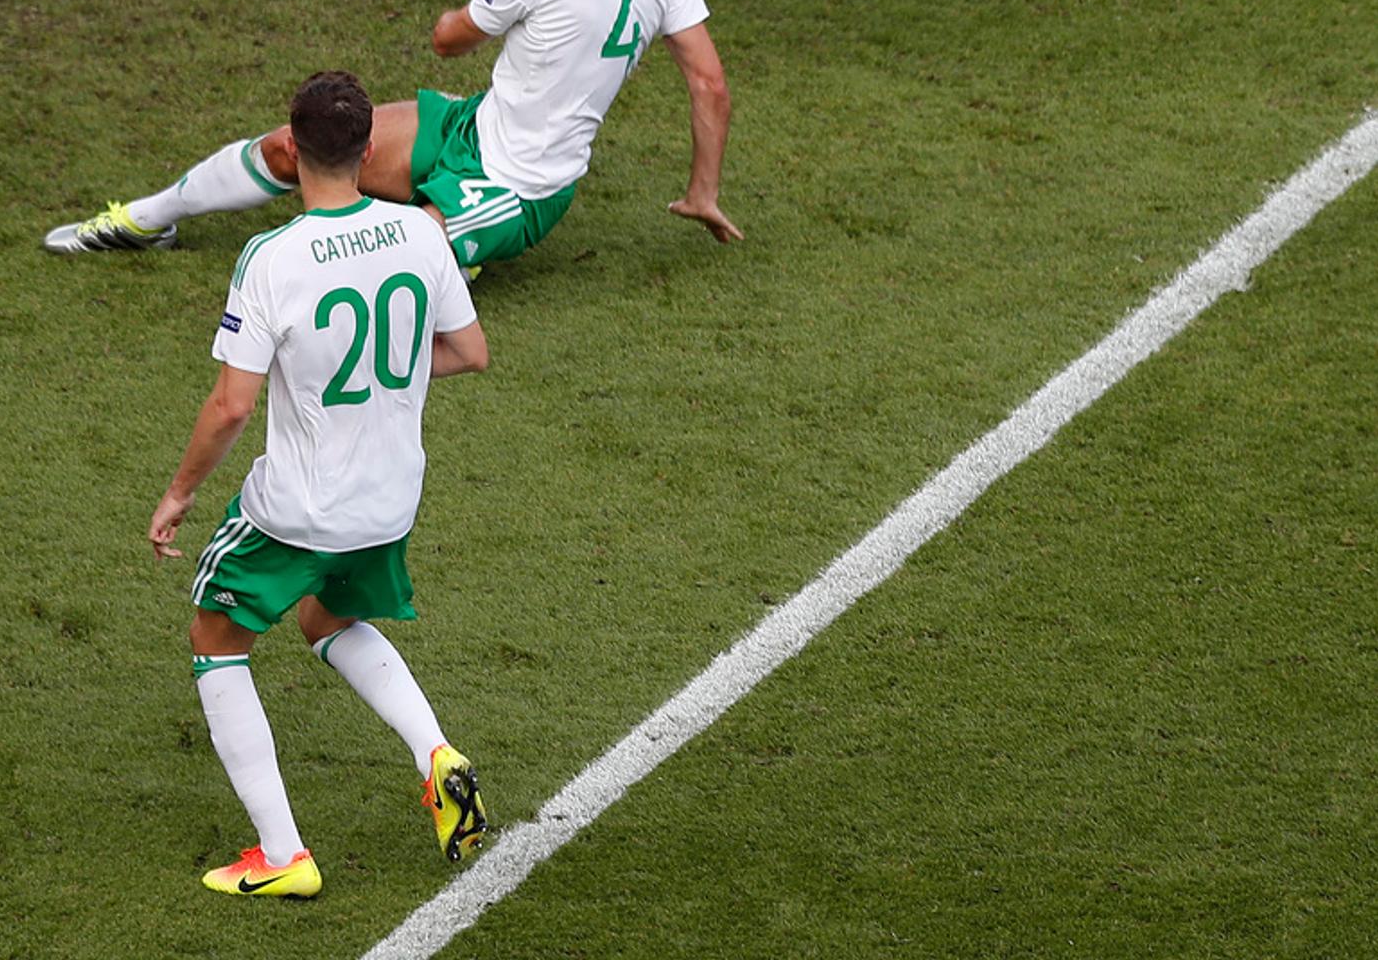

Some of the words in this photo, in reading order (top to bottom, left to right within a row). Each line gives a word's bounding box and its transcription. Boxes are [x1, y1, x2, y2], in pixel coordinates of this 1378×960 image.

[459, 179, 509, 208] 4
[310, 219, 408, 264] CATHCART
[314, 271, 429, 407] 20
